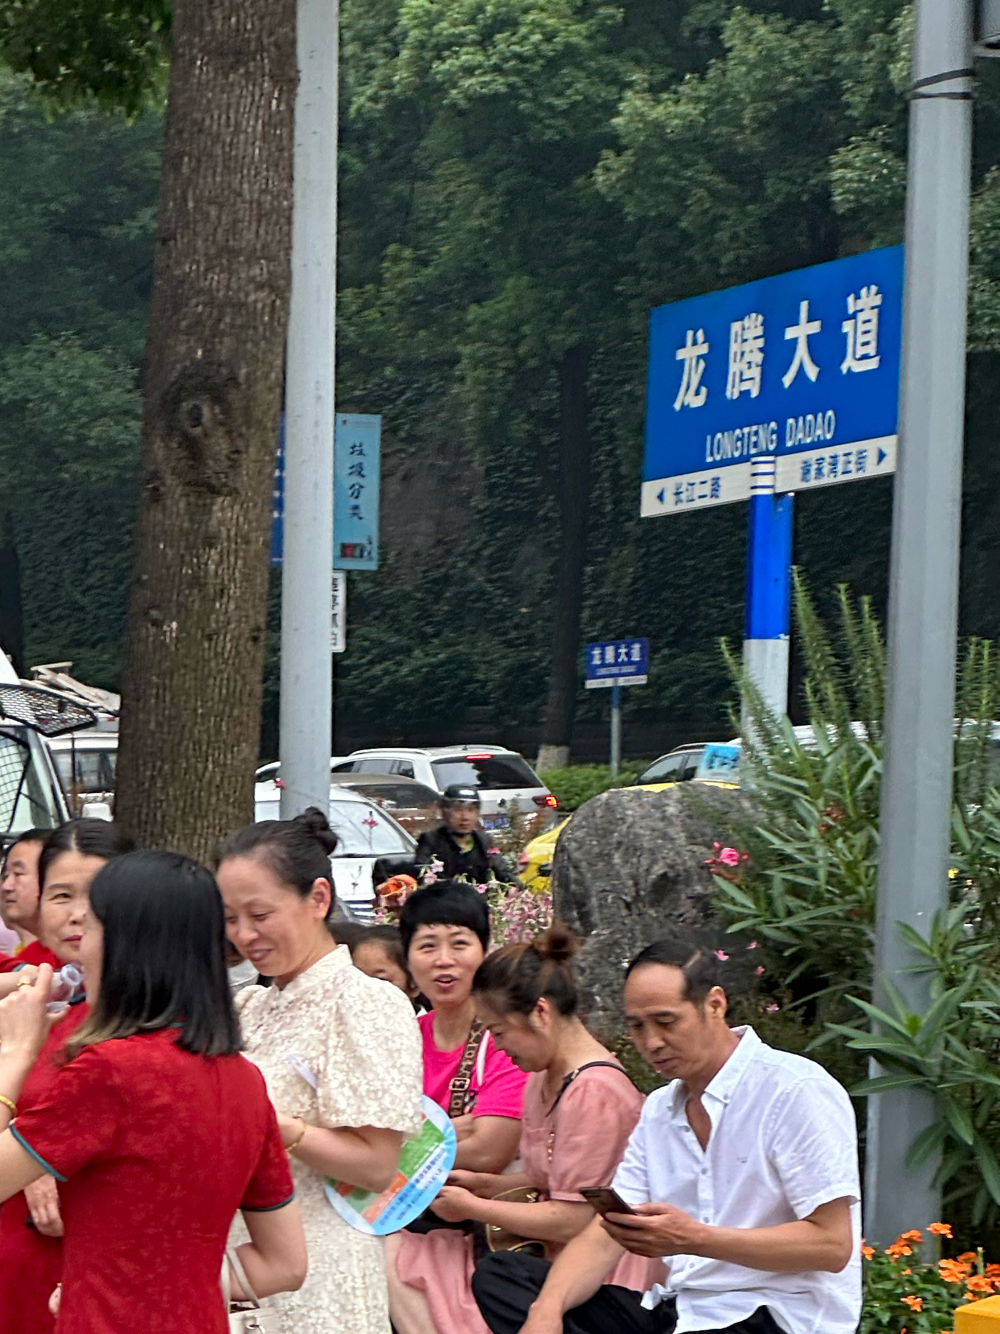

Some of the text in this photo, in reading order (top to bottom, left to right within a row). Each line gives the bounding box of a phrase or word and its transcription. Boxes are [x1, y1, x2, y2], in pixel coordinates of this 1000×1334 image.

[673, 284, 883, 411] 龙腾大道
[705, 409, 836, 463] LONGTENG DADAO
[348, 442, 366, 520] 垃圾分类
[673, 476, 721, 506] 长江二路
